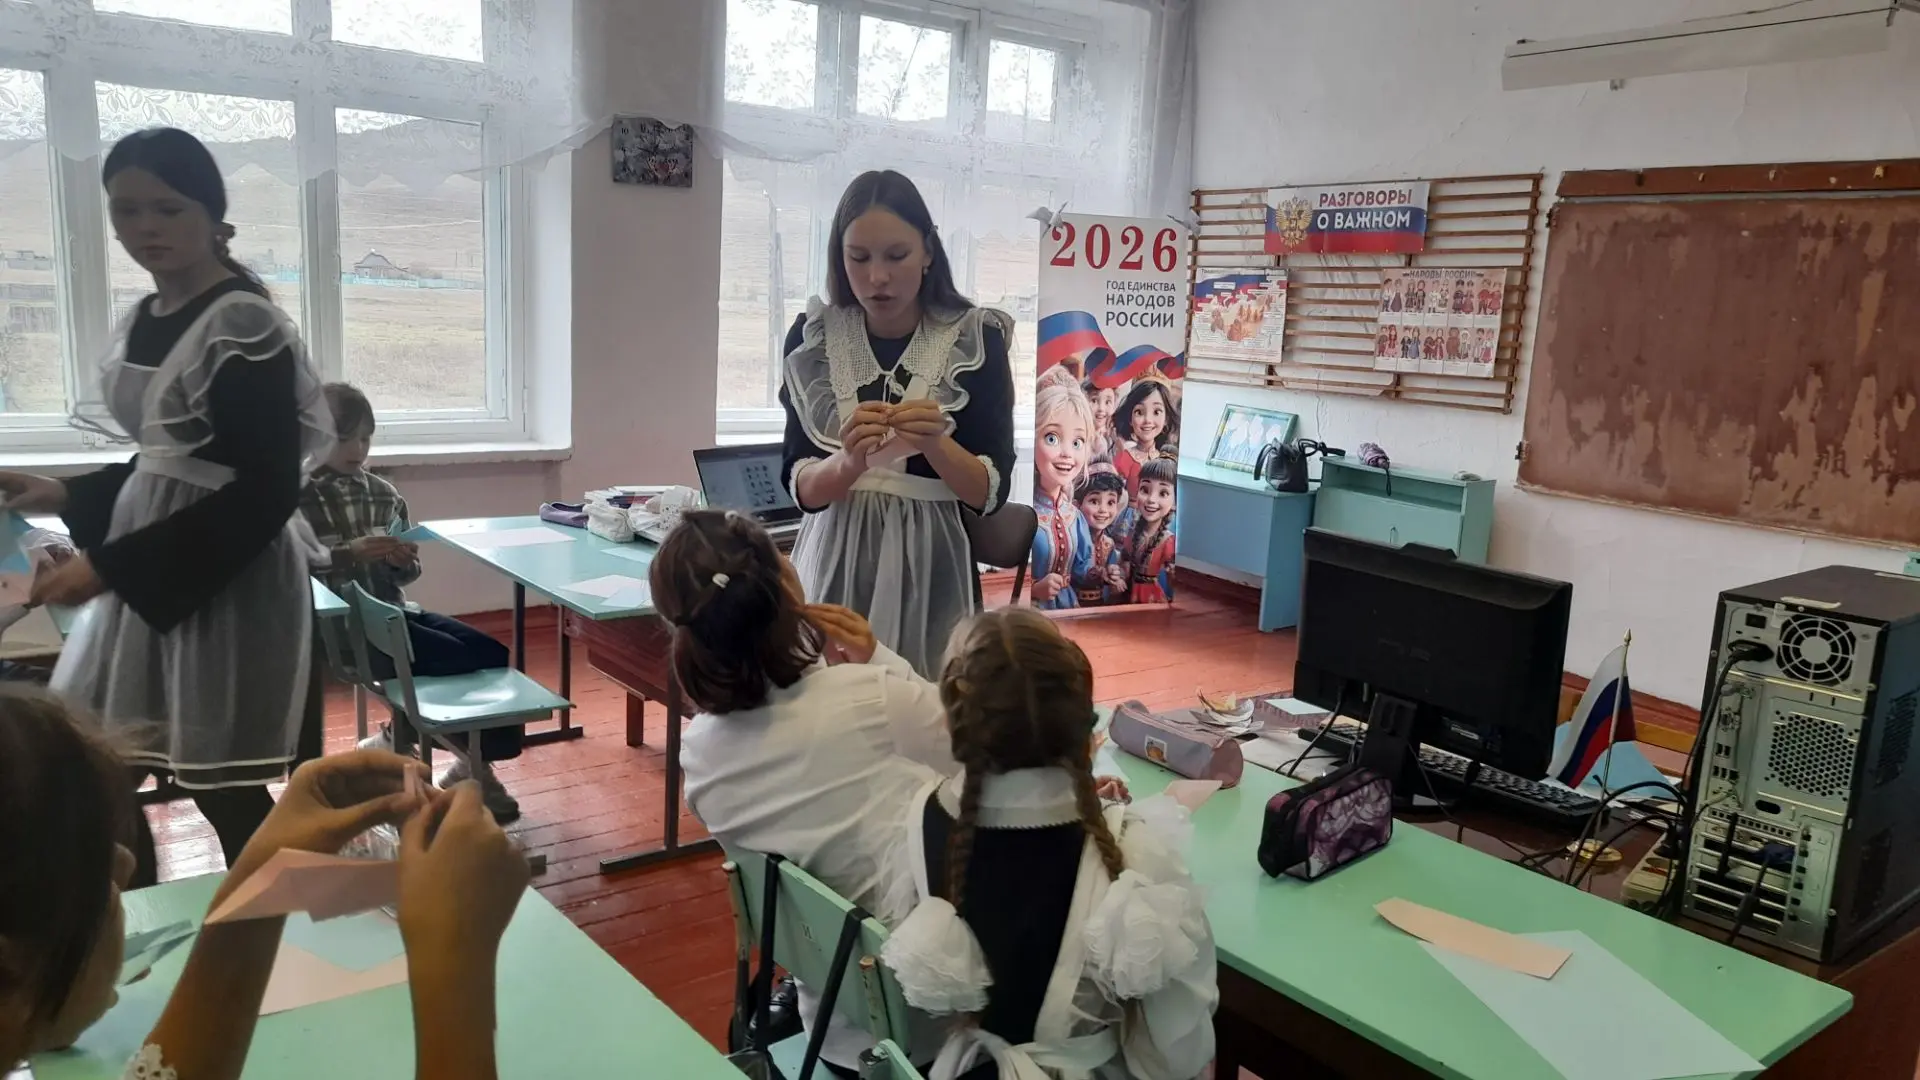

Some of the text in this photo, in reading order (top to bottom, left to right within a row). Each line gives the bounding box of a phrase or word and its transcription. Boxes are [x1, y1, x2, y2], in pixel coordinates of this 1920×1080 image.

[1319, 189, 1412, 207] РАЗГОВОРЫ
[1317, 210, 1411, 229] О ВАЖНОМ
[1050, 221, 1177, 272] 2026
[1410, 269, 1441, 279] НАРОДЫ
[1106, 280, 1176, 292] ГОД ЕДИНСТВА
[1106, 294, 1175, 309] НАРОДОВ
[1105, 311, 1174, 328] РОССИИ
